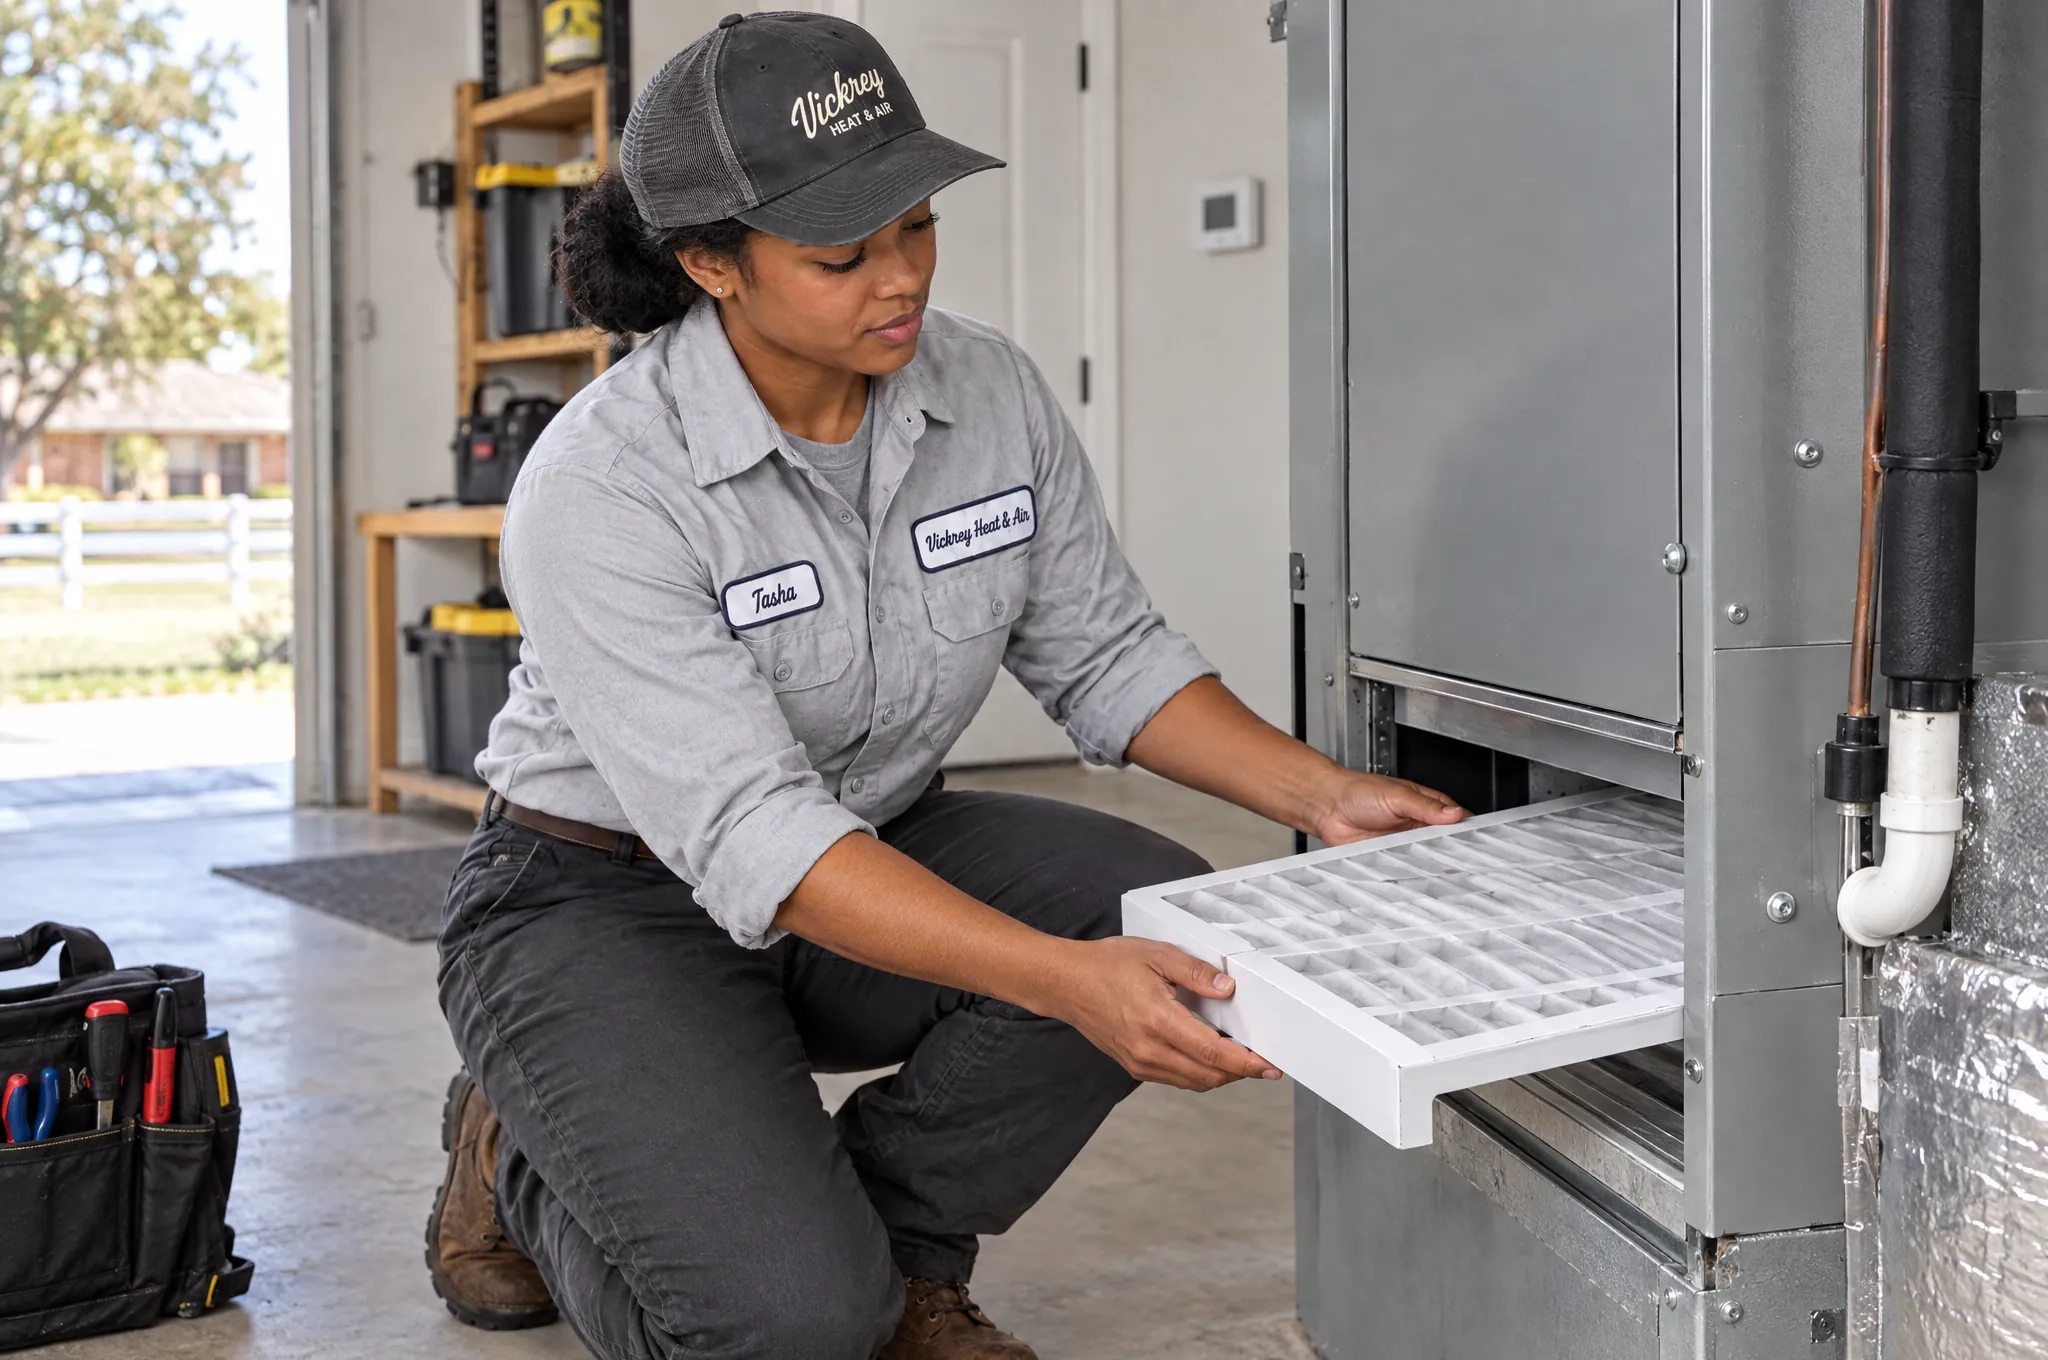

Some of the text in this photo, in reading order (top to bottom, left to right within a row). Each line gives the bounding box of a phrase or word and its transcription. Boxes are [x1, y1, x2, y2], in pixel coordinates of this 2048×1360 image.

[791, 69, 885, 139] Vickrey
[829, 102, 893, 136] HEAT & AIR
[925, 507, 1030, 553] Vickrey Heat & Air
[752, 583, 797, 614] Tasha
